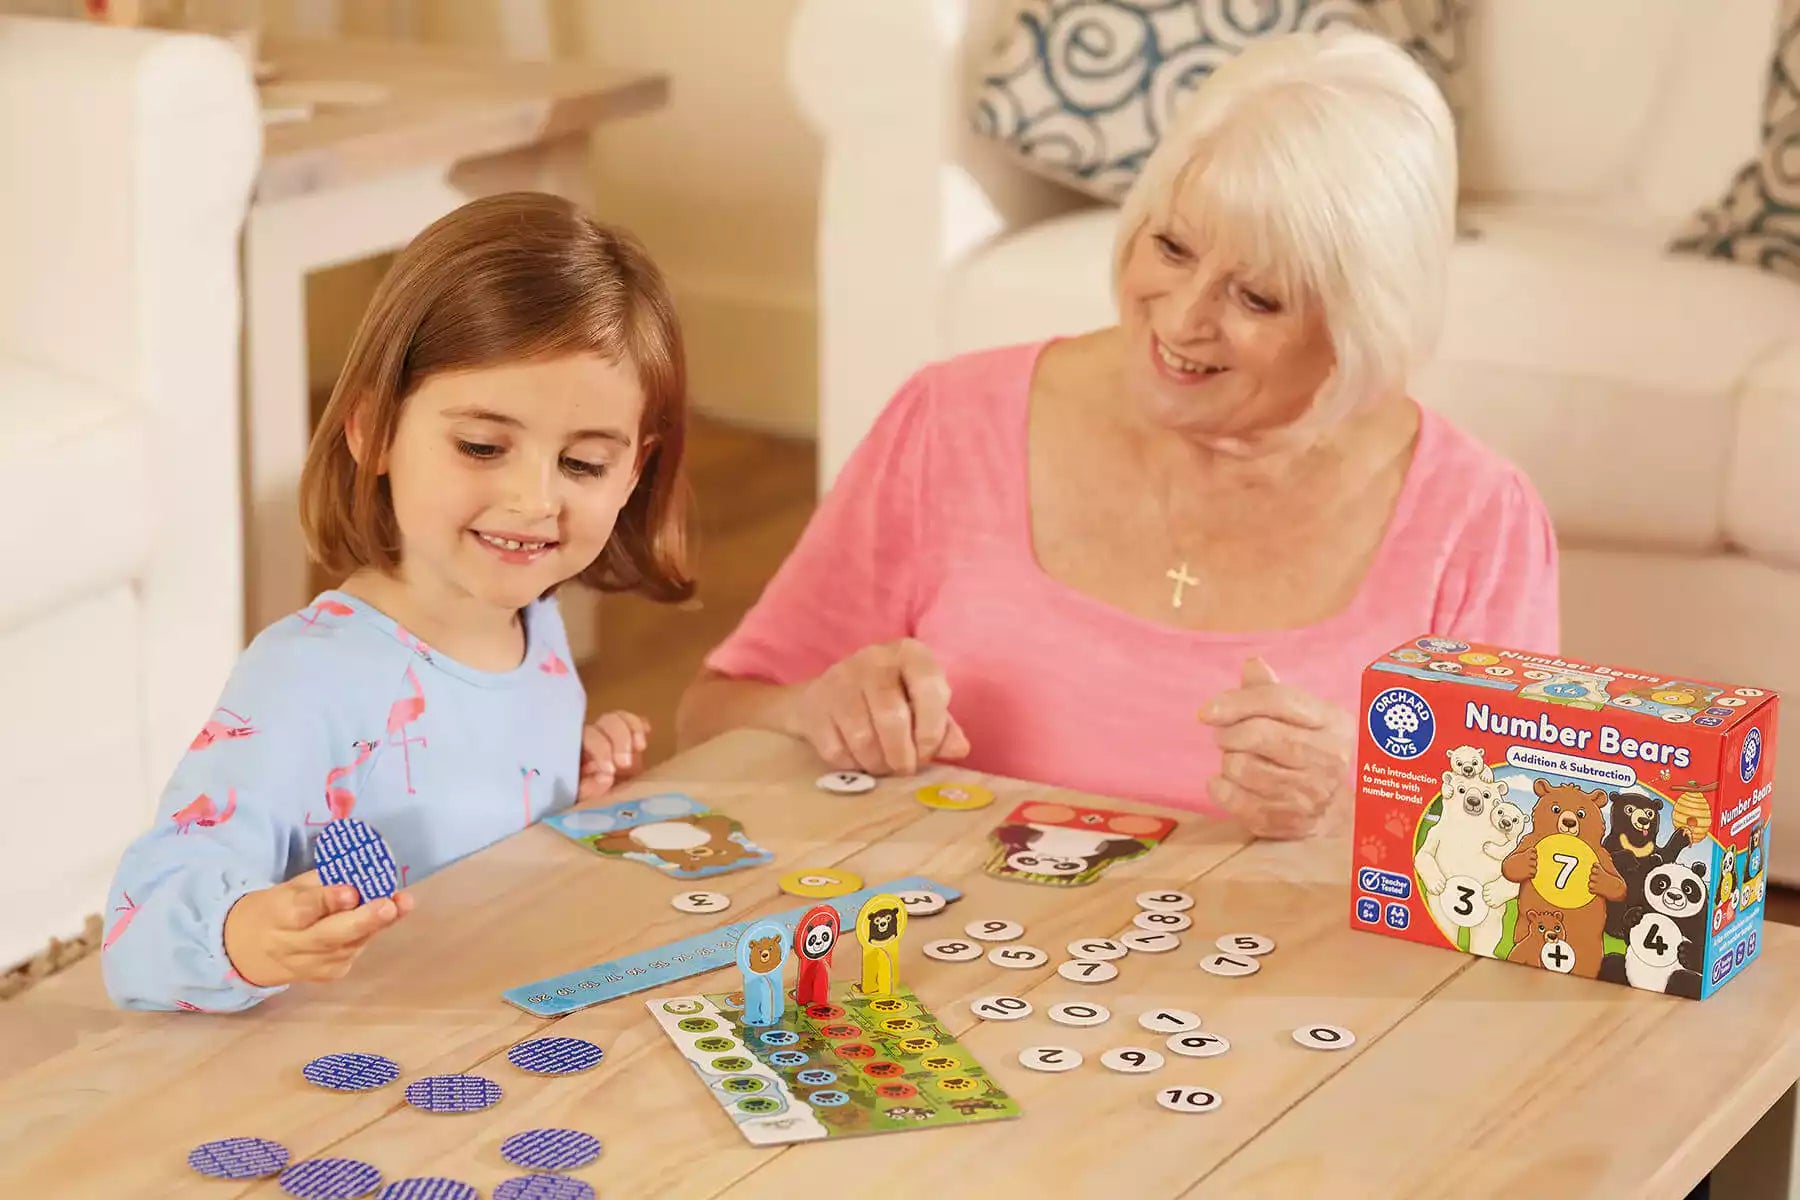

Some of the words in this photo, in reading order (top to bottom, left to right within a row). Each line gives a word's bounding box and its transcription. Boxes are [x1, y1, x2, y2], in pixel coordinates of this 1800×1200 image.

[1499, 650, 1591, 671] Number
[1594, 666, 1660, 684] Bears
[1553, 685, 1579, 696] 14
[1375, 691, 1430, 721] ORCHARD
[1465, 701, 1592, 750] Number
[1600, 726, 1691, 769] Bears
[1384, 737, 1417, 756] TOYS
[1363, 763, 1371, 772] A
[1371, 764, 1386, 775] fun
[1387, 767, 1438, 785] introduction
[1513, 752, 1557, 769] Addition
[1559, 760, 1568, 770] &
[1569, 762, 1631, 782] Subtraction
[1363, 774, 1372, 783] to
[1373, 776, 1400, 789] maths
[1401, 782, 1420, 793] with
[1362, 786, 1395, 799] number
[1395, 793, 1423, 805] bonds!
[1720, 797, 1752, 828] Number
[1752, 782, 1772, 805] Bears
[1552, 853, 1580, 890] 7
[1381, 876, 1408, 888] Teacher
[1381, 883, 1403, 894] Tested
[688, 894, 713, 907] 3
[1453, 885, 1476, 916] 3
[1147, 914, 1182, 925] 8
[1080, 940, 1118, 954] 2
[1233, 936, 1260, 950] 5
[1643, 923, 1669, 956] 4
[936, 942, 971, 955] 8
[1001, 949, 1036, 963] 5
[625, 966, 647, 977] 16
[1077, 962, 1102, 977] 7
[578, 980, 601, 990] 18
[604, 973, 624, 983] 17
[527, 992, 553, 1005] 20
[556, 986, 576, 997] 19
[980, 996, 1028, 1016] 10
[1062, 1005, 1099, 1019] 0
[1155, 1012, 1186, 1026] 1
[1308, 1027, 1342, 1044] 0
[1037, 1048, 1064, 1065] 2
[1166, 1089, 1217, 1108] 10
